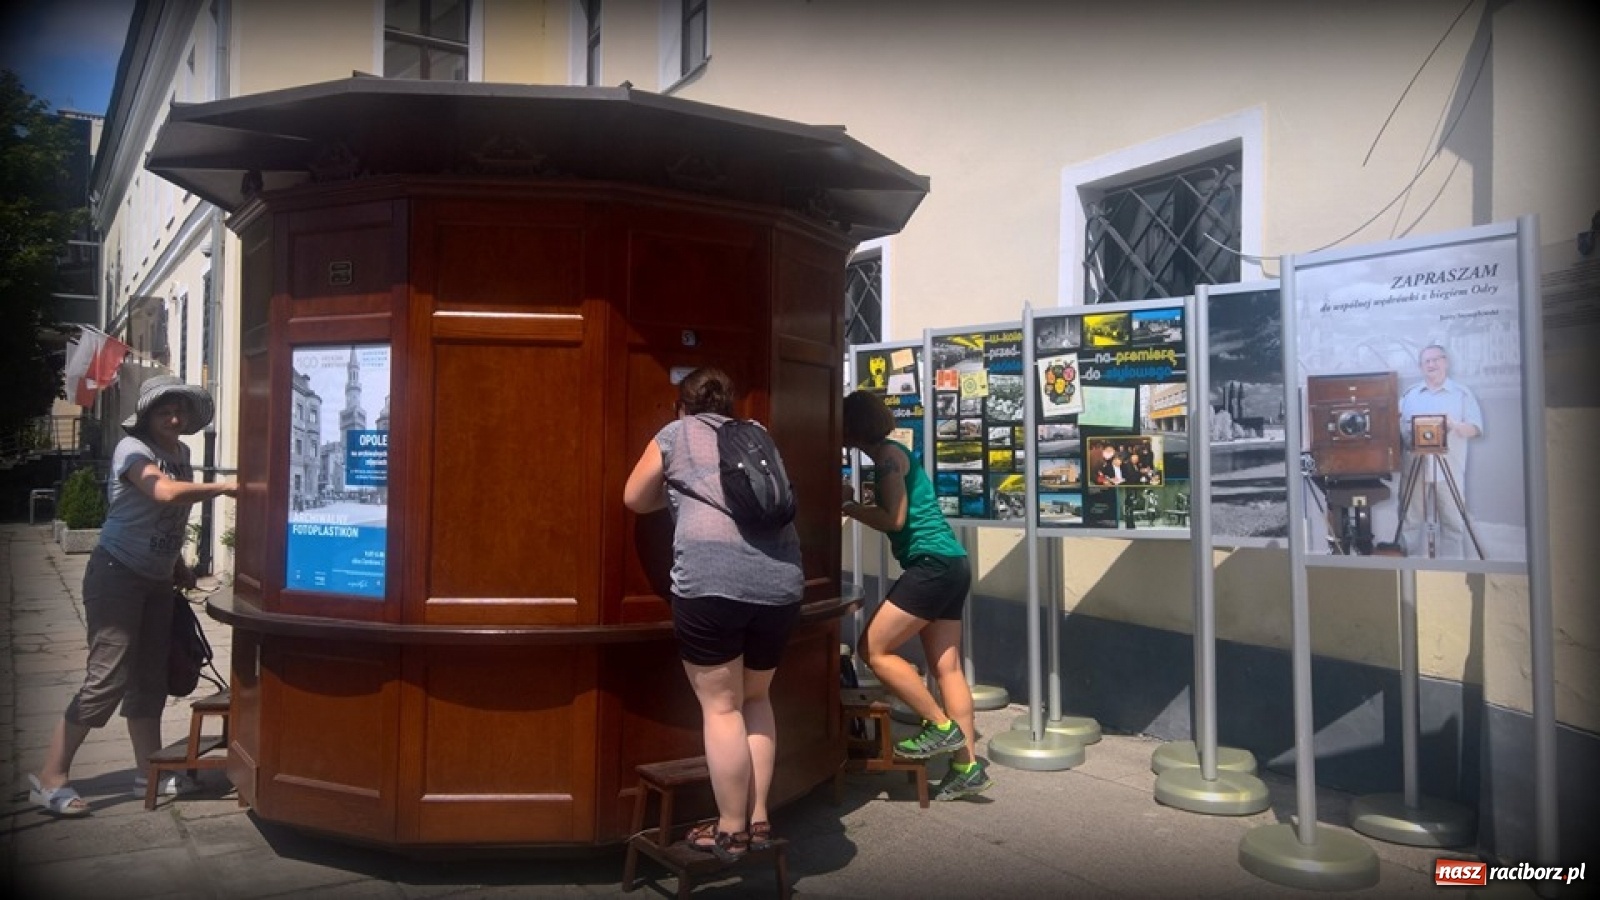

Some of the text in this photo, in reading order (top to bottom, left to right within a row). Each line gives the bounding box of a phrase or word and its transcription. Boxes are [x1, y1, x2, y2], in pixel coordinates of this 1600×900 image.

[1390, 263, 1498, 290] ZAPRASZAM
[1319, 284, 1498, 313] do wspólnej wędrówki z biegiem Odry
[1094, 347, 1177, 367] na premierę
[1084, 366, 1101, 381] do
[359, 434, 388, 446] OPOLE
[293, 511, 348, 525] ARCHIWALNY
[292, 524, 359, 538] FOTOPLASTIKON
